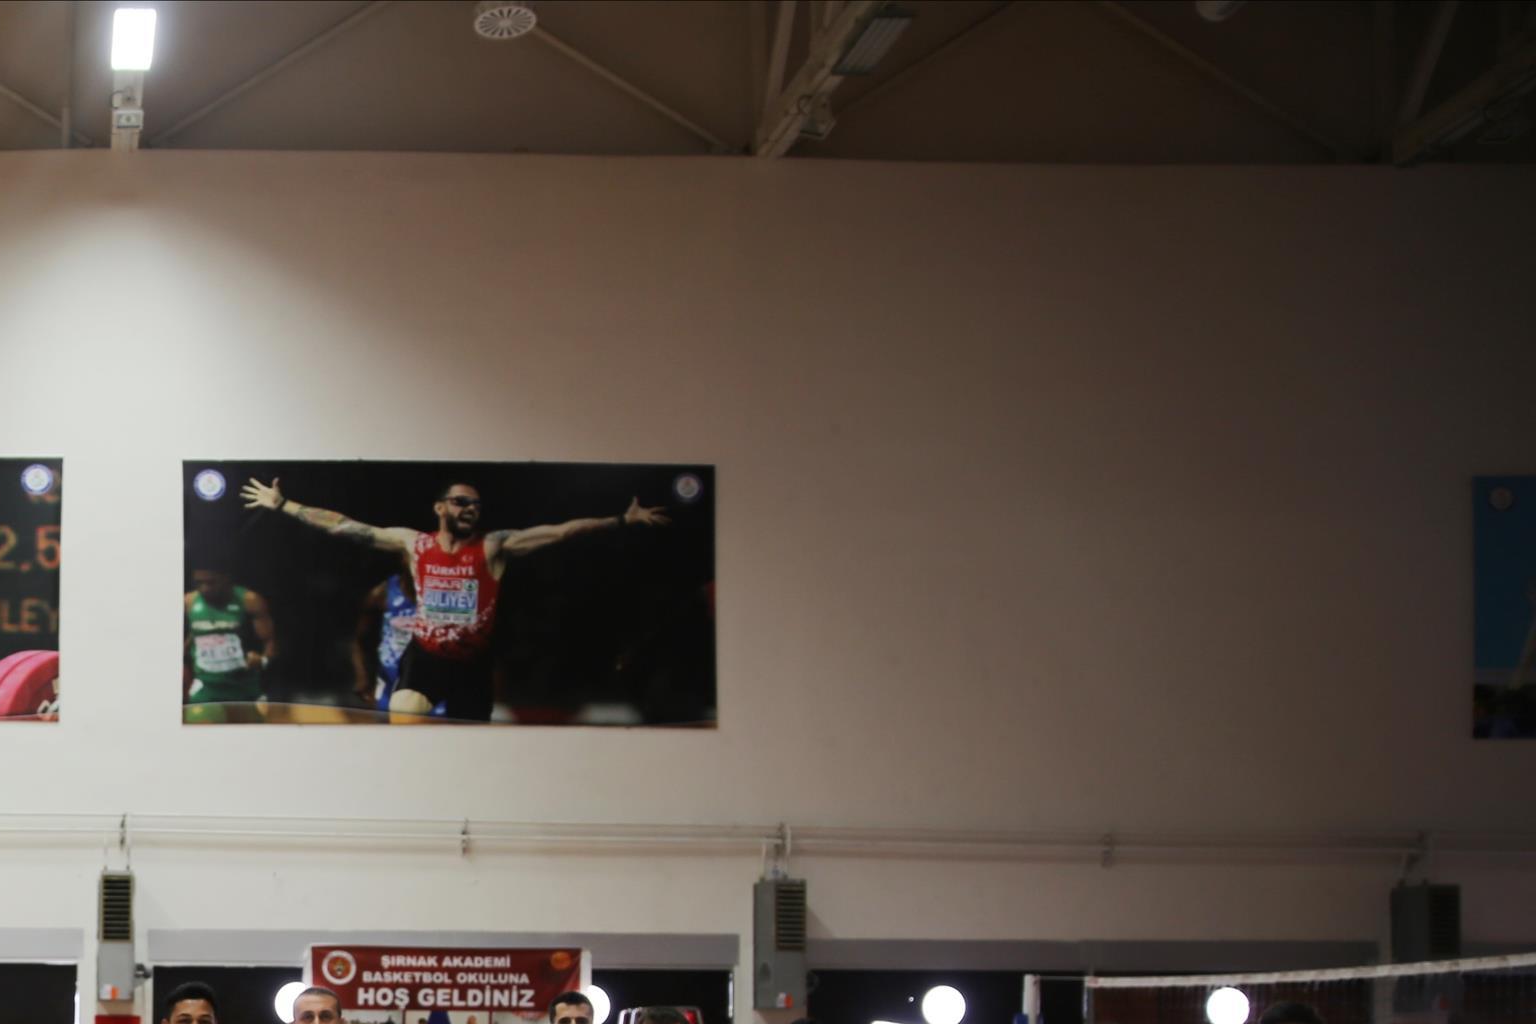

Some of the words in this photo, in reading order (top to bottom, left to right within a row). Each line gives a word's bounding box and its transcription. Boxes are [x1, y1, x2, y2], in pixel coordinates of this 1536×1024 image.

[380, 954, 438, 969] ŞIRNAK
[441, 954, 511, 968] AKADEMİ
[362, 970, 452, 984] BASKETBOL
[456, 972, 529, 985] OKULUNA
[357, 987, 410, 1009] HOŞ
[417, 985, 535, 1008] GELDİNİZ
